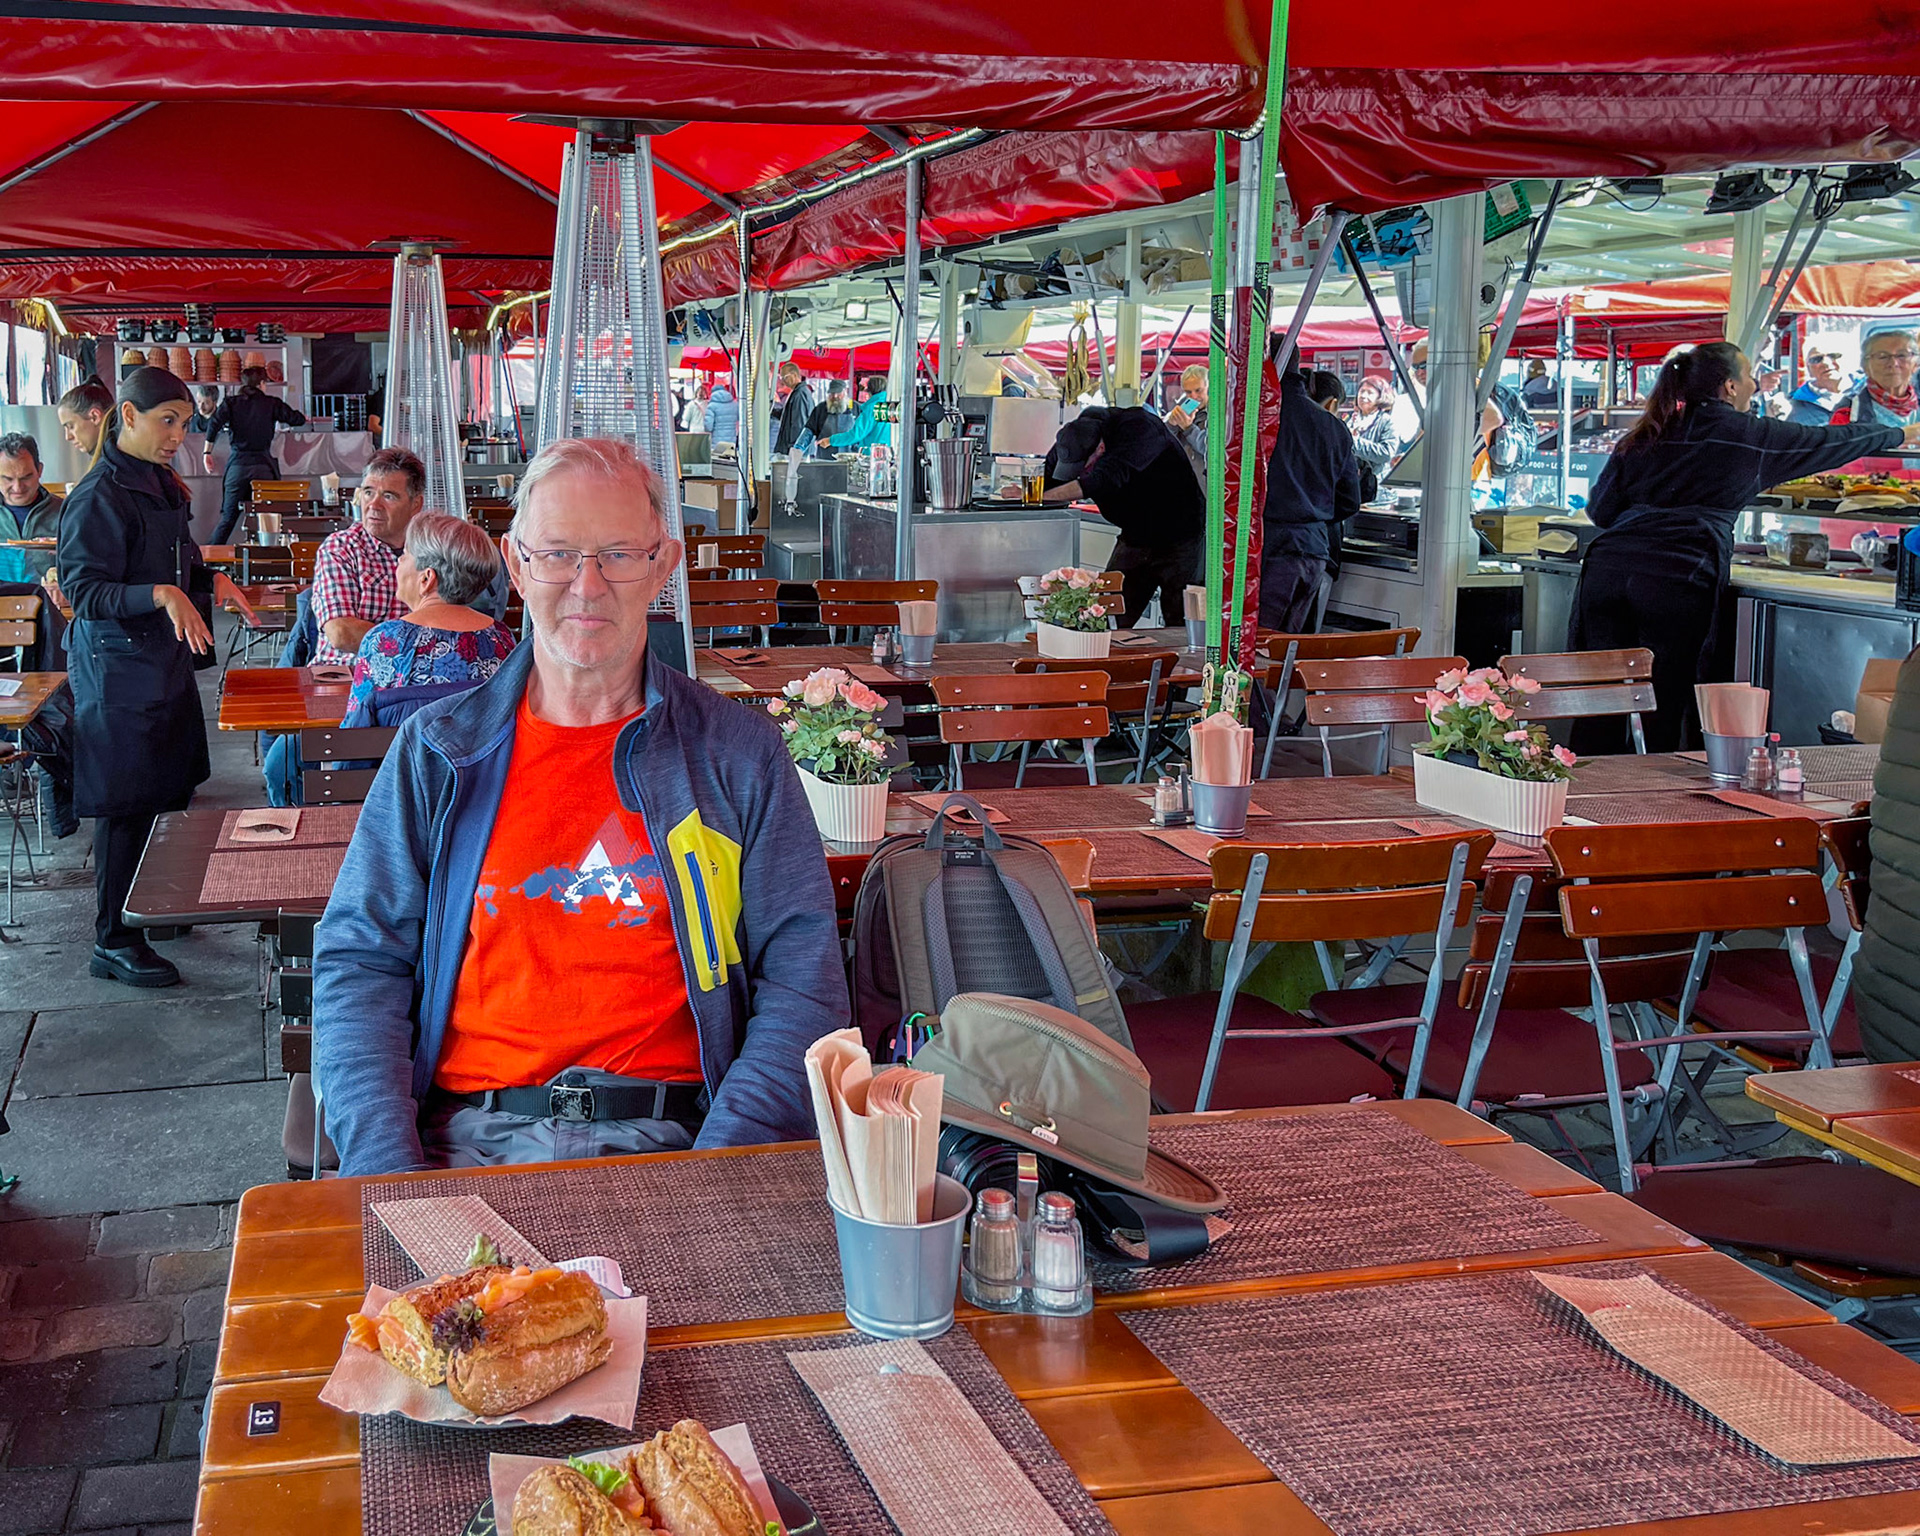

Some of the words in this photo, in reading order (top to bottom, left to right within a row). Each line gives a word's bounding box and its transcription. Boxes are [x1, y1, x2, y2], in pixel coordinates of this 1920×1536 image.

[1261, 263, 1269, 290] SMART
[1217, 296, 1225, 320] SMART
[254, 1408, 274, 1425] 13
